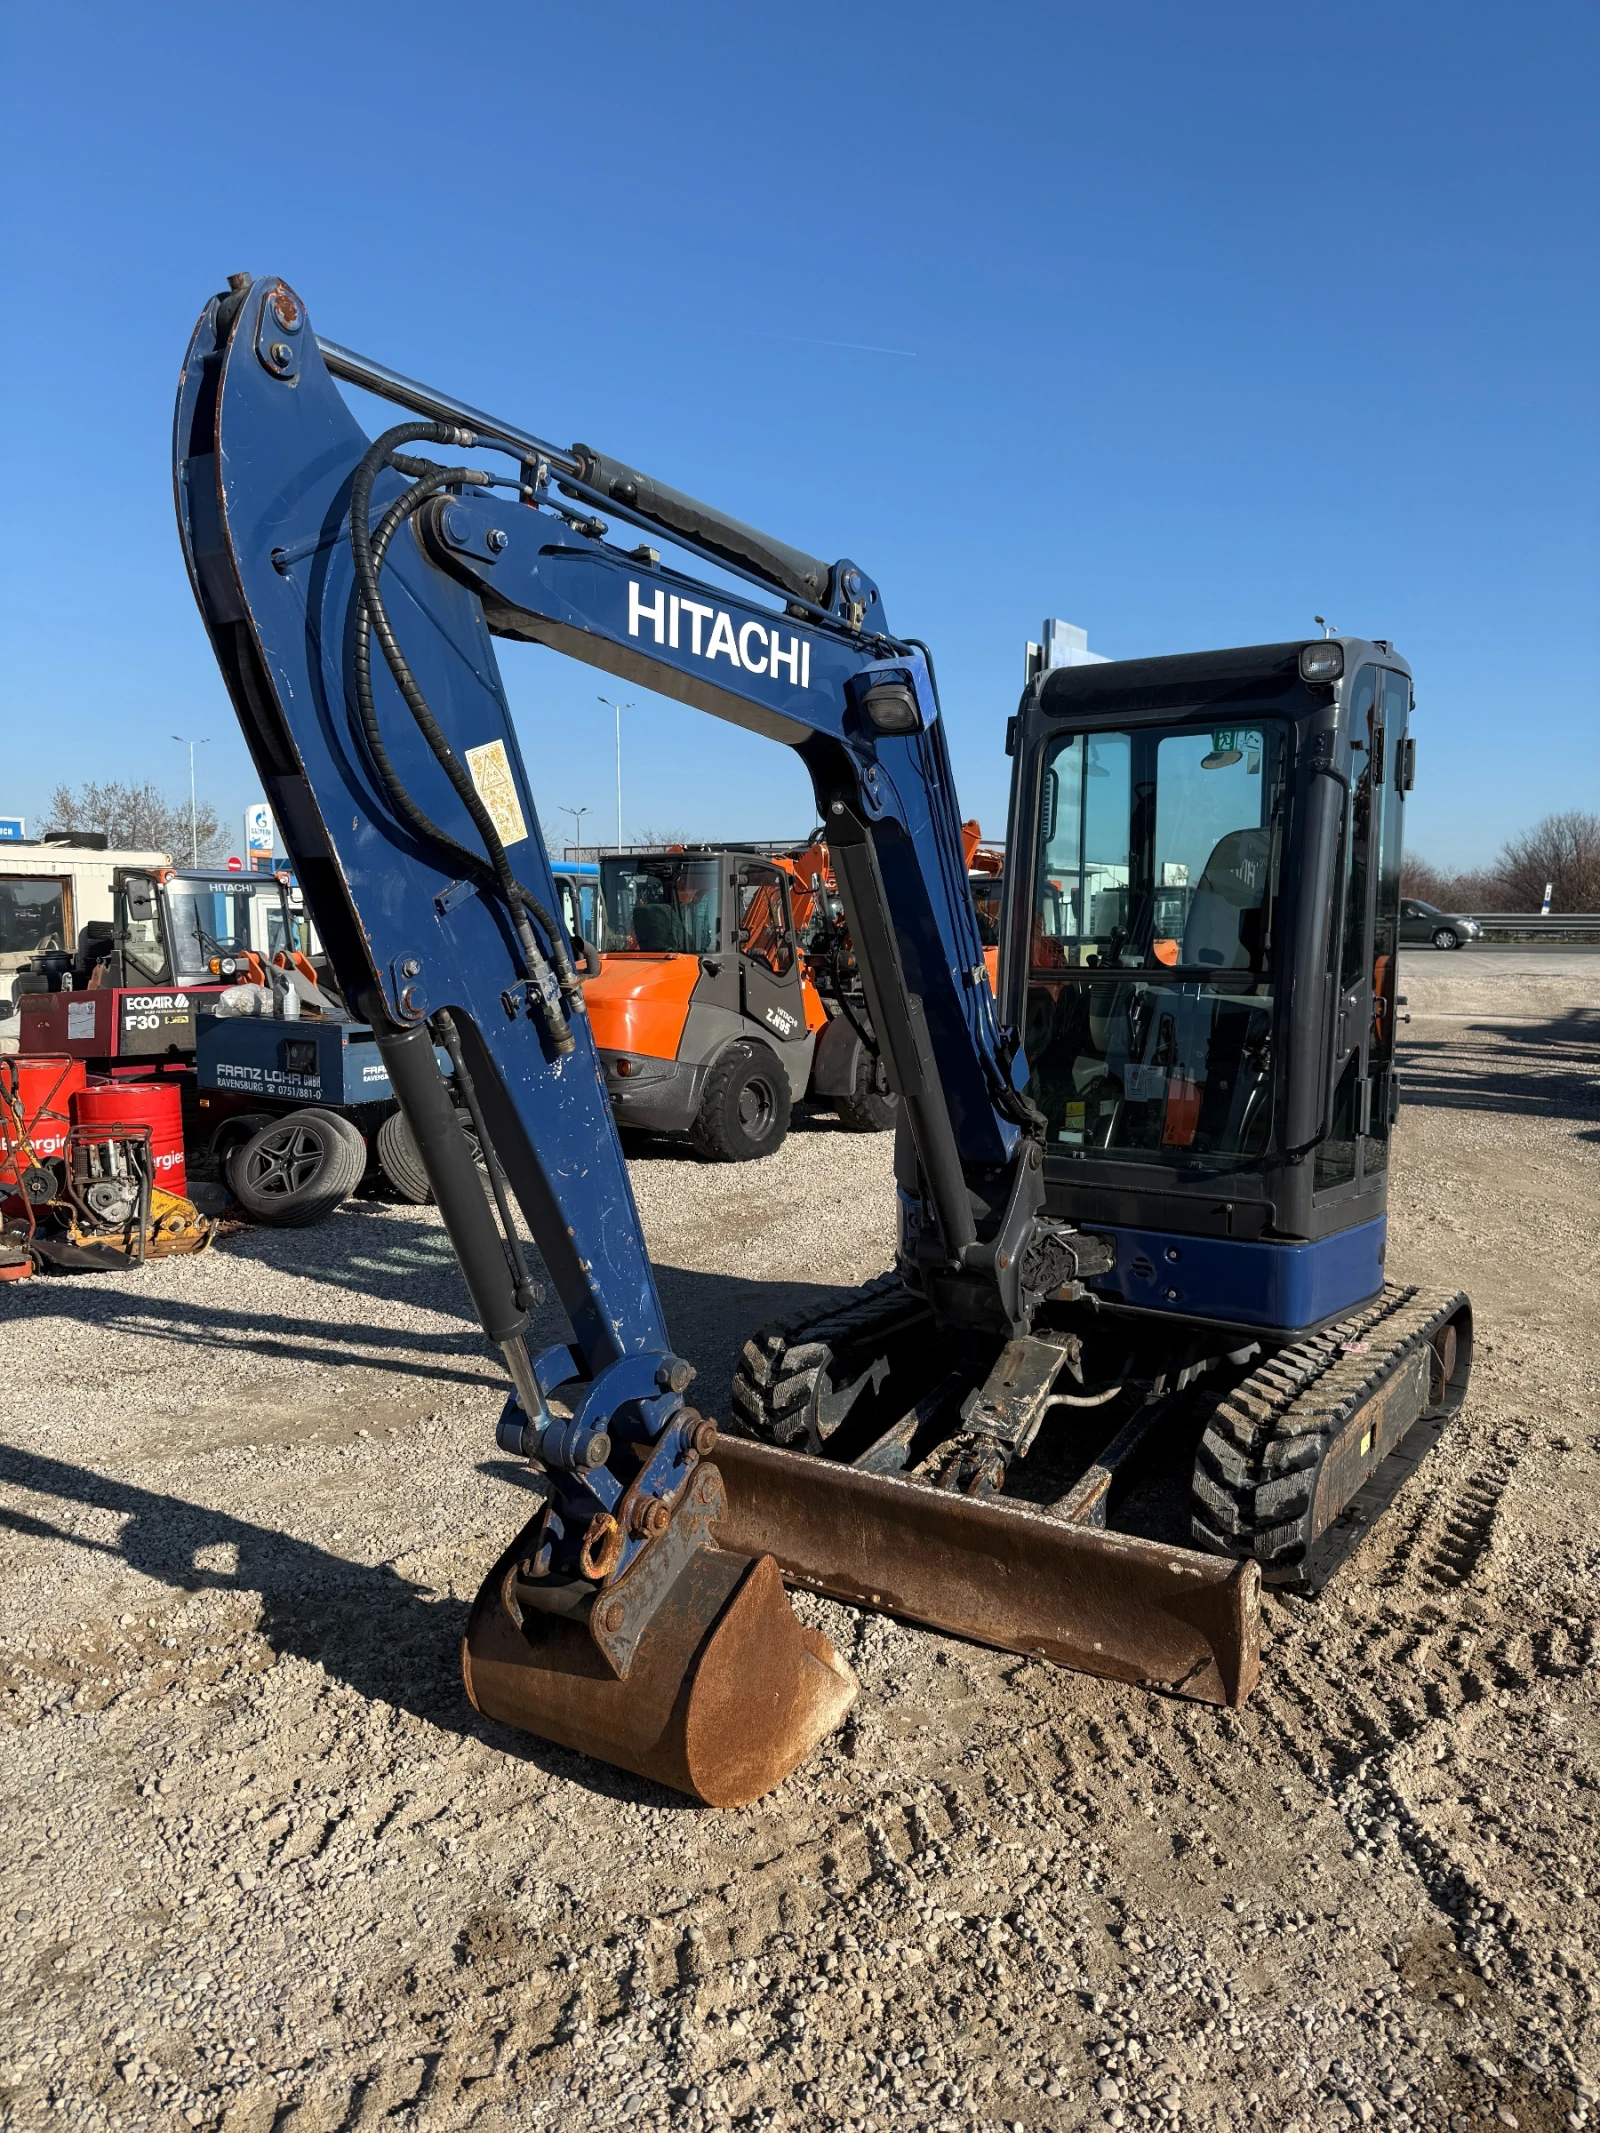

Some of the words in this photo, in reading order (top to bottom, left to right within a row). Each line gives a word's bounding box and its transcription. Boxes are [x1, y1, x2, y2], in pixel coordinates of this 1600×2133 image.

[628, 581, 811, 689] HITACHI
[209, 883, 253, 892] HITACHI
[126, 996, 173, 1011] ECOAIR
[125, 1015, 160, 1031] F30
[777, 1006, 798, 1028] HITACHI
[216, 1063, 262, 1080] FRANZ
[264, 1069, 302, 1085] LOHR
[363, 1065, 388, 1076] FRA
[217, 1077, 264, 1092] RAVENSBURG
[278, 1085, 322, 1100] 0751/881-0
